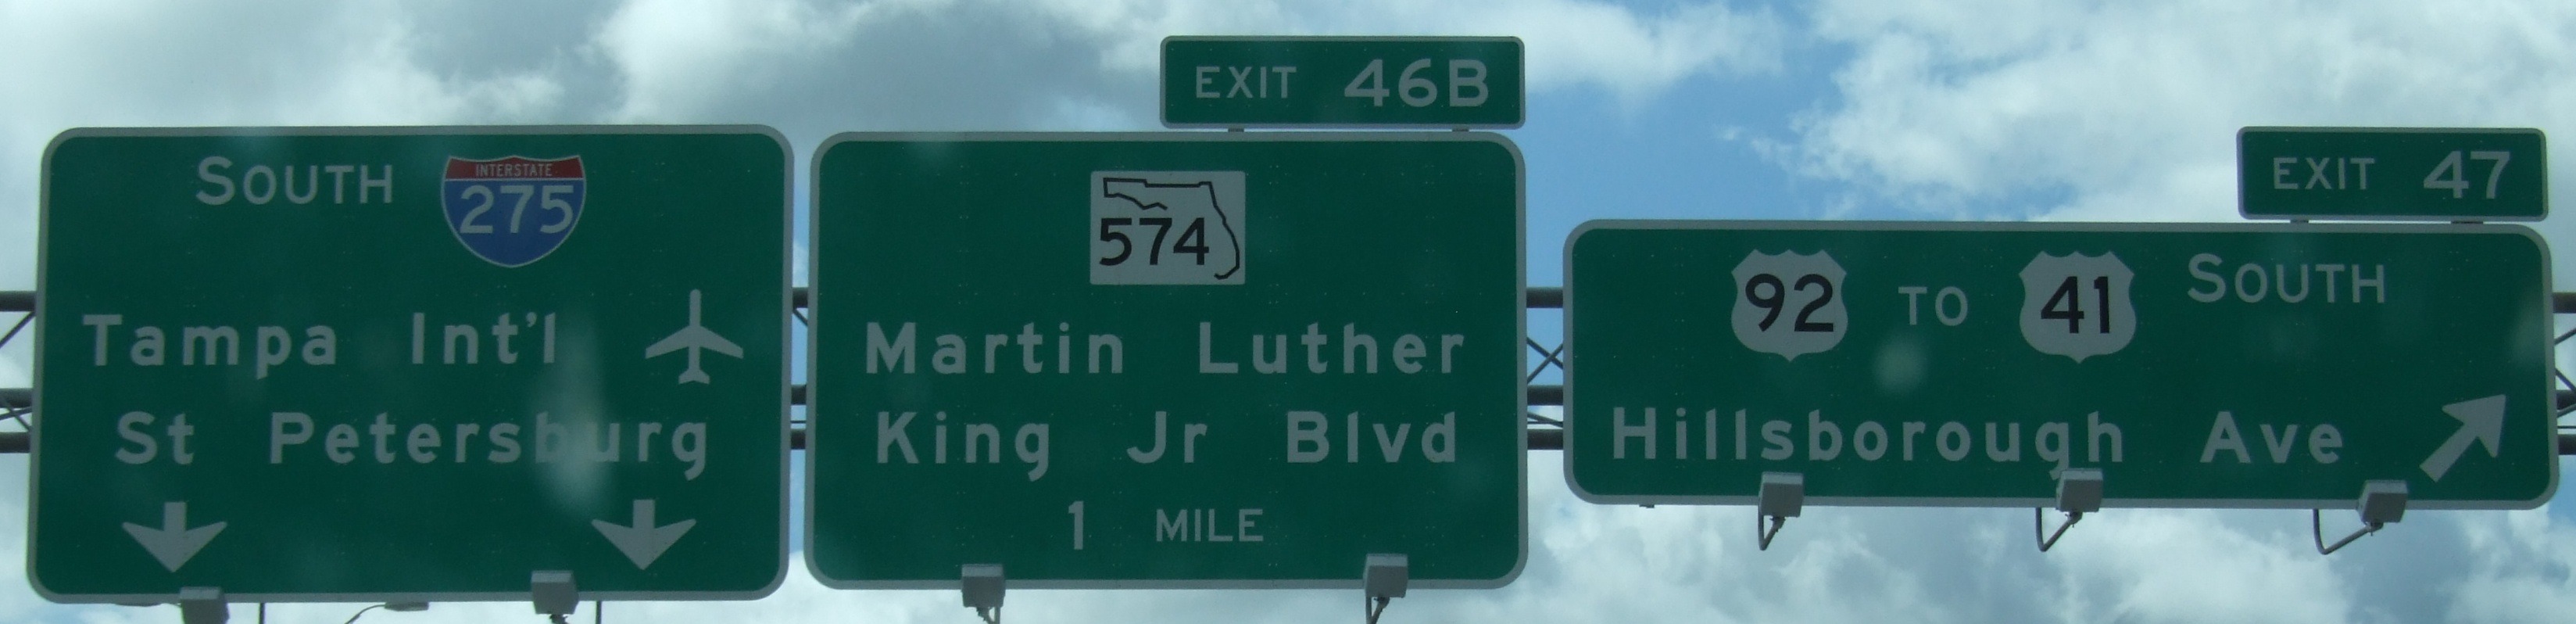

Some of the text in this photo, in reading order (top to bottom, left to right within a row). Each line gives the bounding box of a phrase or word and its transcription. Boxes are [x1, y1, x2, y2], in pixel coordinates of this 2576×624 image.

[1196, 59, 1489, 108] EXIT 46B
[195, 156, 392, 206] SOUTH
[475, 163, 553, 177] INTERSTATE
[2273, 150, 2510, 199] EXIT 47
[460, 184, 574, 234] 275
[1100, 217, 1209, 267] 574
[1744, 253, 2385, 334] 92 TO 41 SOUTH
[83, 312, 556, 379] Tampa Int'l
[866, 322, 1464, 375] Martin Luther
[116, 411, 707, 481] St Petersburg
[878, 411, 1455, 482] King Jr Blvd
[1613, 407, 2345, 481] Hillsborough Ave
[1068, 500, 1264, 550] 1 MILE
